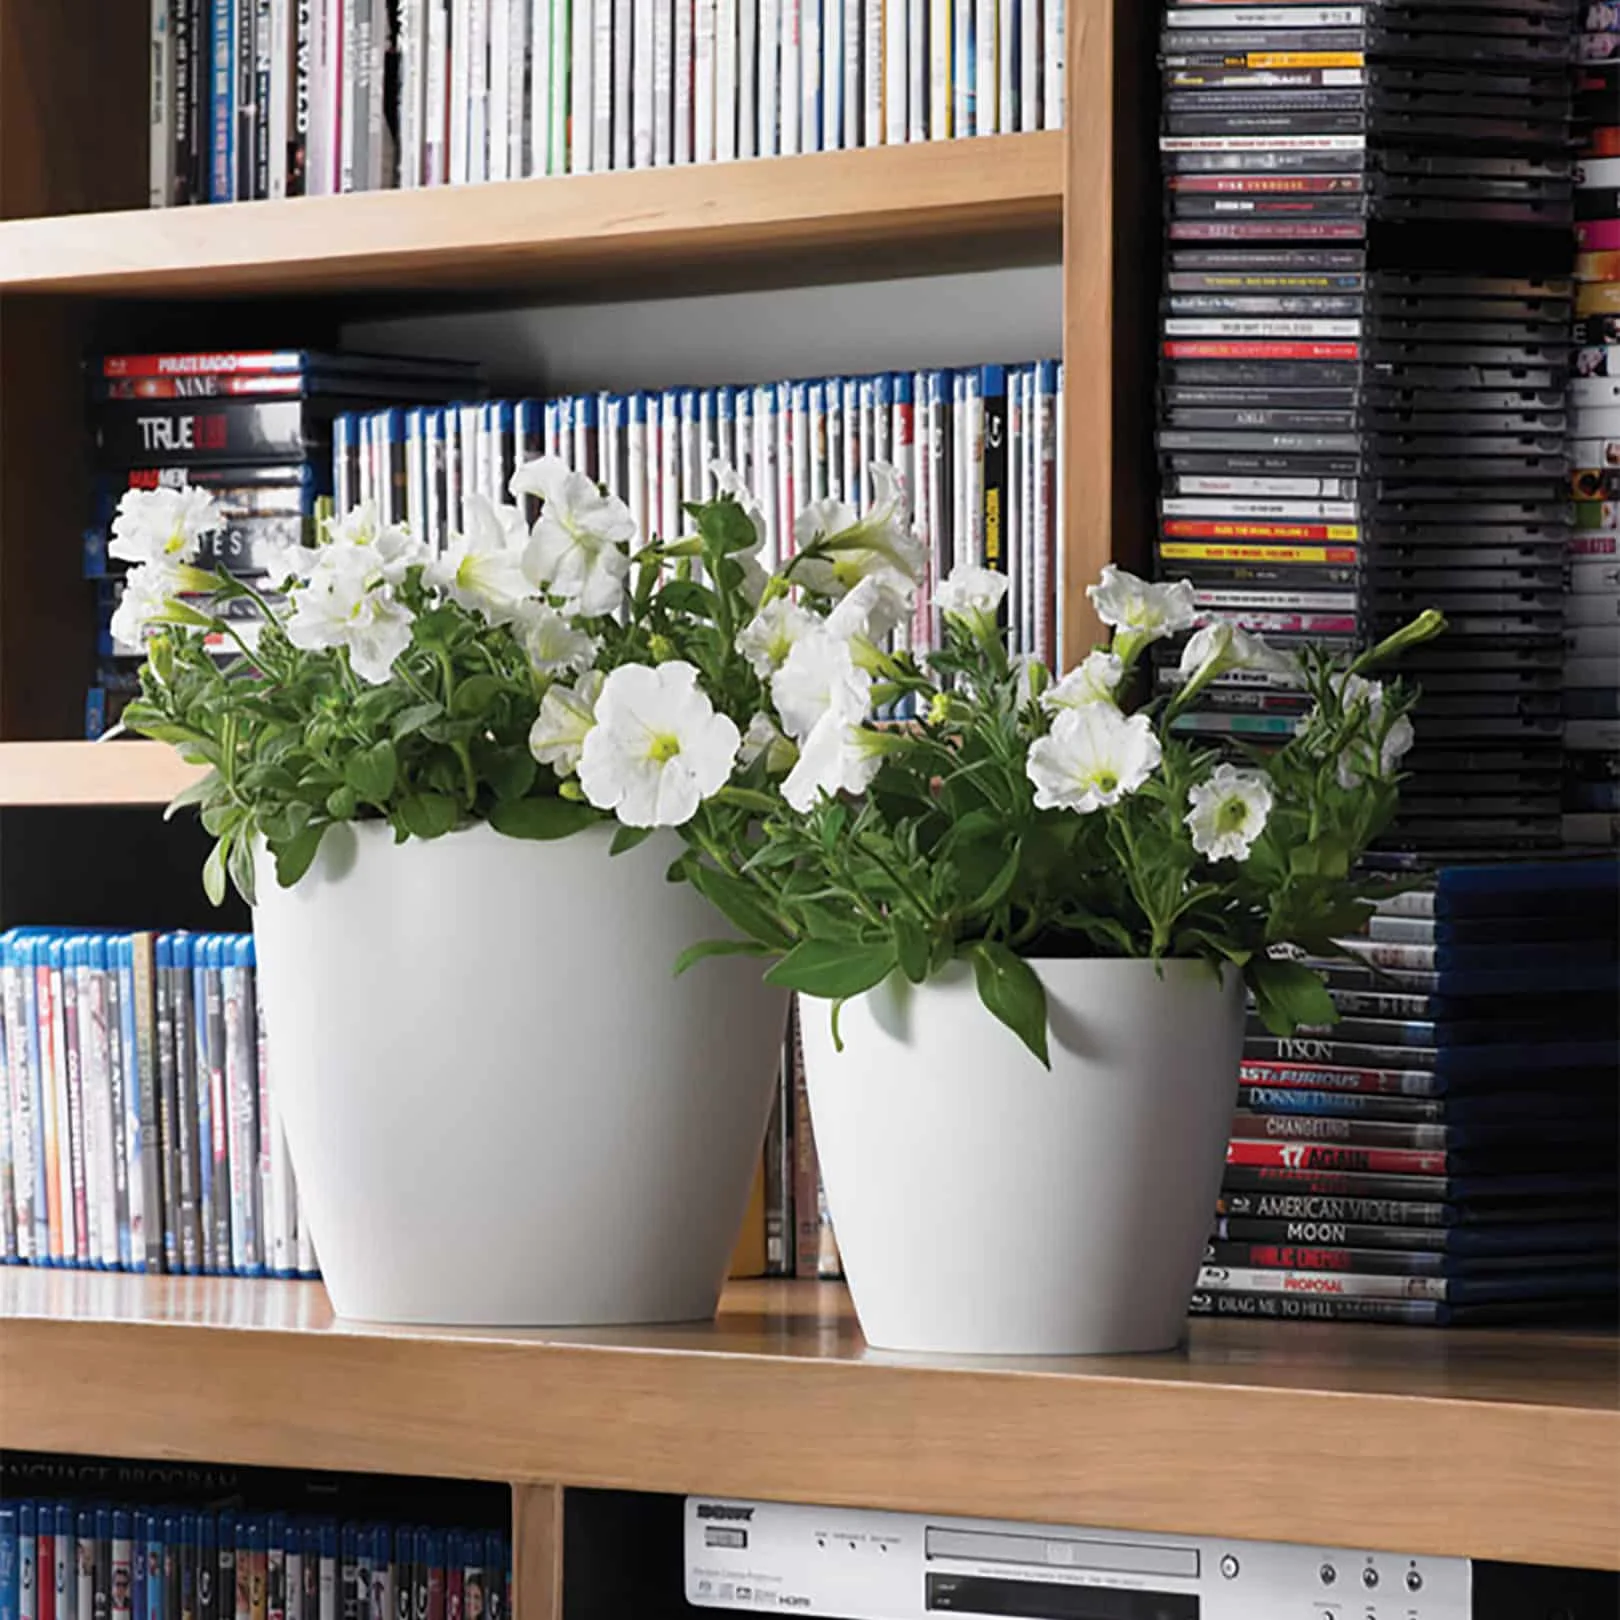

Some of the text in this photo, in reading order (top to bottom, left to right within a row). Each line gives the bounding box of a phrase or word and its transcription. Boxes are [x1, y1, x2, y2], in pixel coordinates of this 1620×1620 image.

[174, 376, 217, 397] NINE
[137, 415, 195, 450] TRUE
[1277, 1039, 1333, 1060] TYSON
[1266, 1117, 1350, 1137] CHANGELING
[1280, 1146, 1305, 1168] 17
[1257, 1198, 1408, 1222] AMERICAN VIOLET
[1287, 1223, 1346, 1241] MOON
[1284, 1277, 1344, 1293] PROPOSAL
[1219, 1297, 1254, 1313] DRAG
[1282, 1299, 1300, 1315] TO
[1302, 1300, 1333, 1317] HELL
[778, 1595, 811, 1607] HDMI
